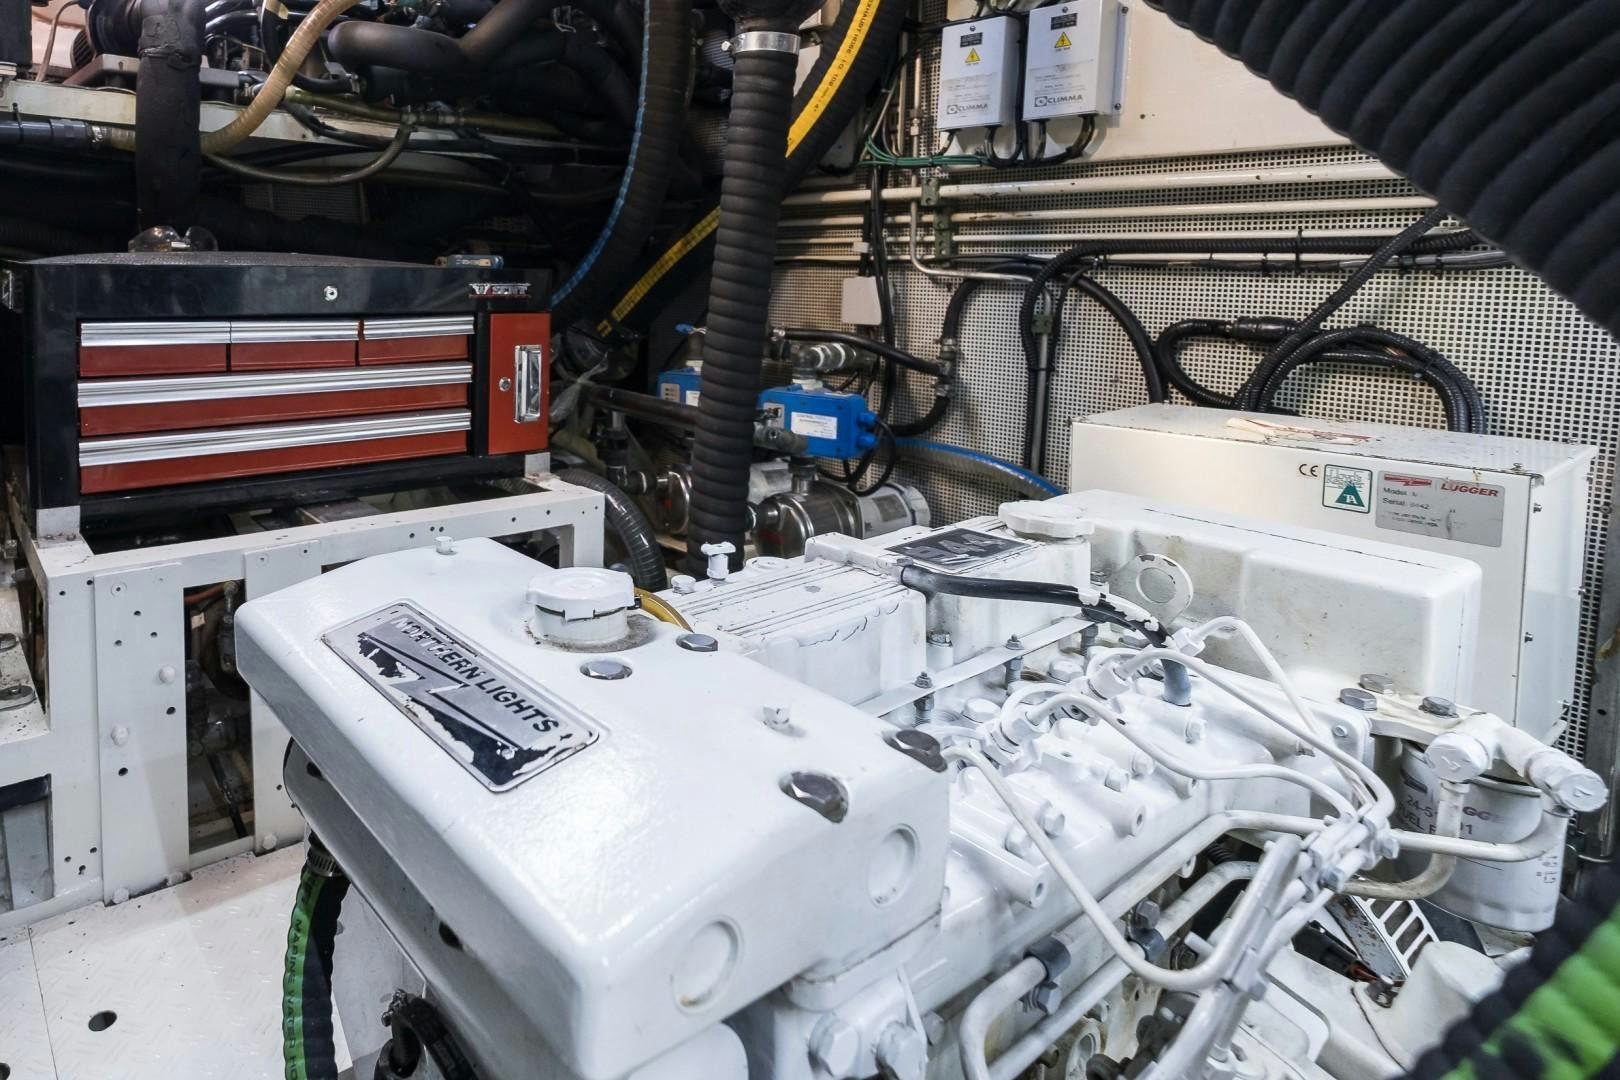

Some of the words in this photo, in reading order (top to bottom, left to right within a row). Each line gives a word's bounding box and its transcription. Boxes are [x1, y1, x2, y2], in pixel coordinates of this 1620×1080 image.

[958, 103, 989, 113] CLIMMA
[1047, 94, 1084, 105] CLIMMA
[1440, 482, 1500, 497] LUGGER
[392, 615, 487, 680] NORTHERN
[475, 677, 560, 733] LIGHTS
[286, 918, 303, 984] MARINE
[285, 990, 297, 1049] WATER
